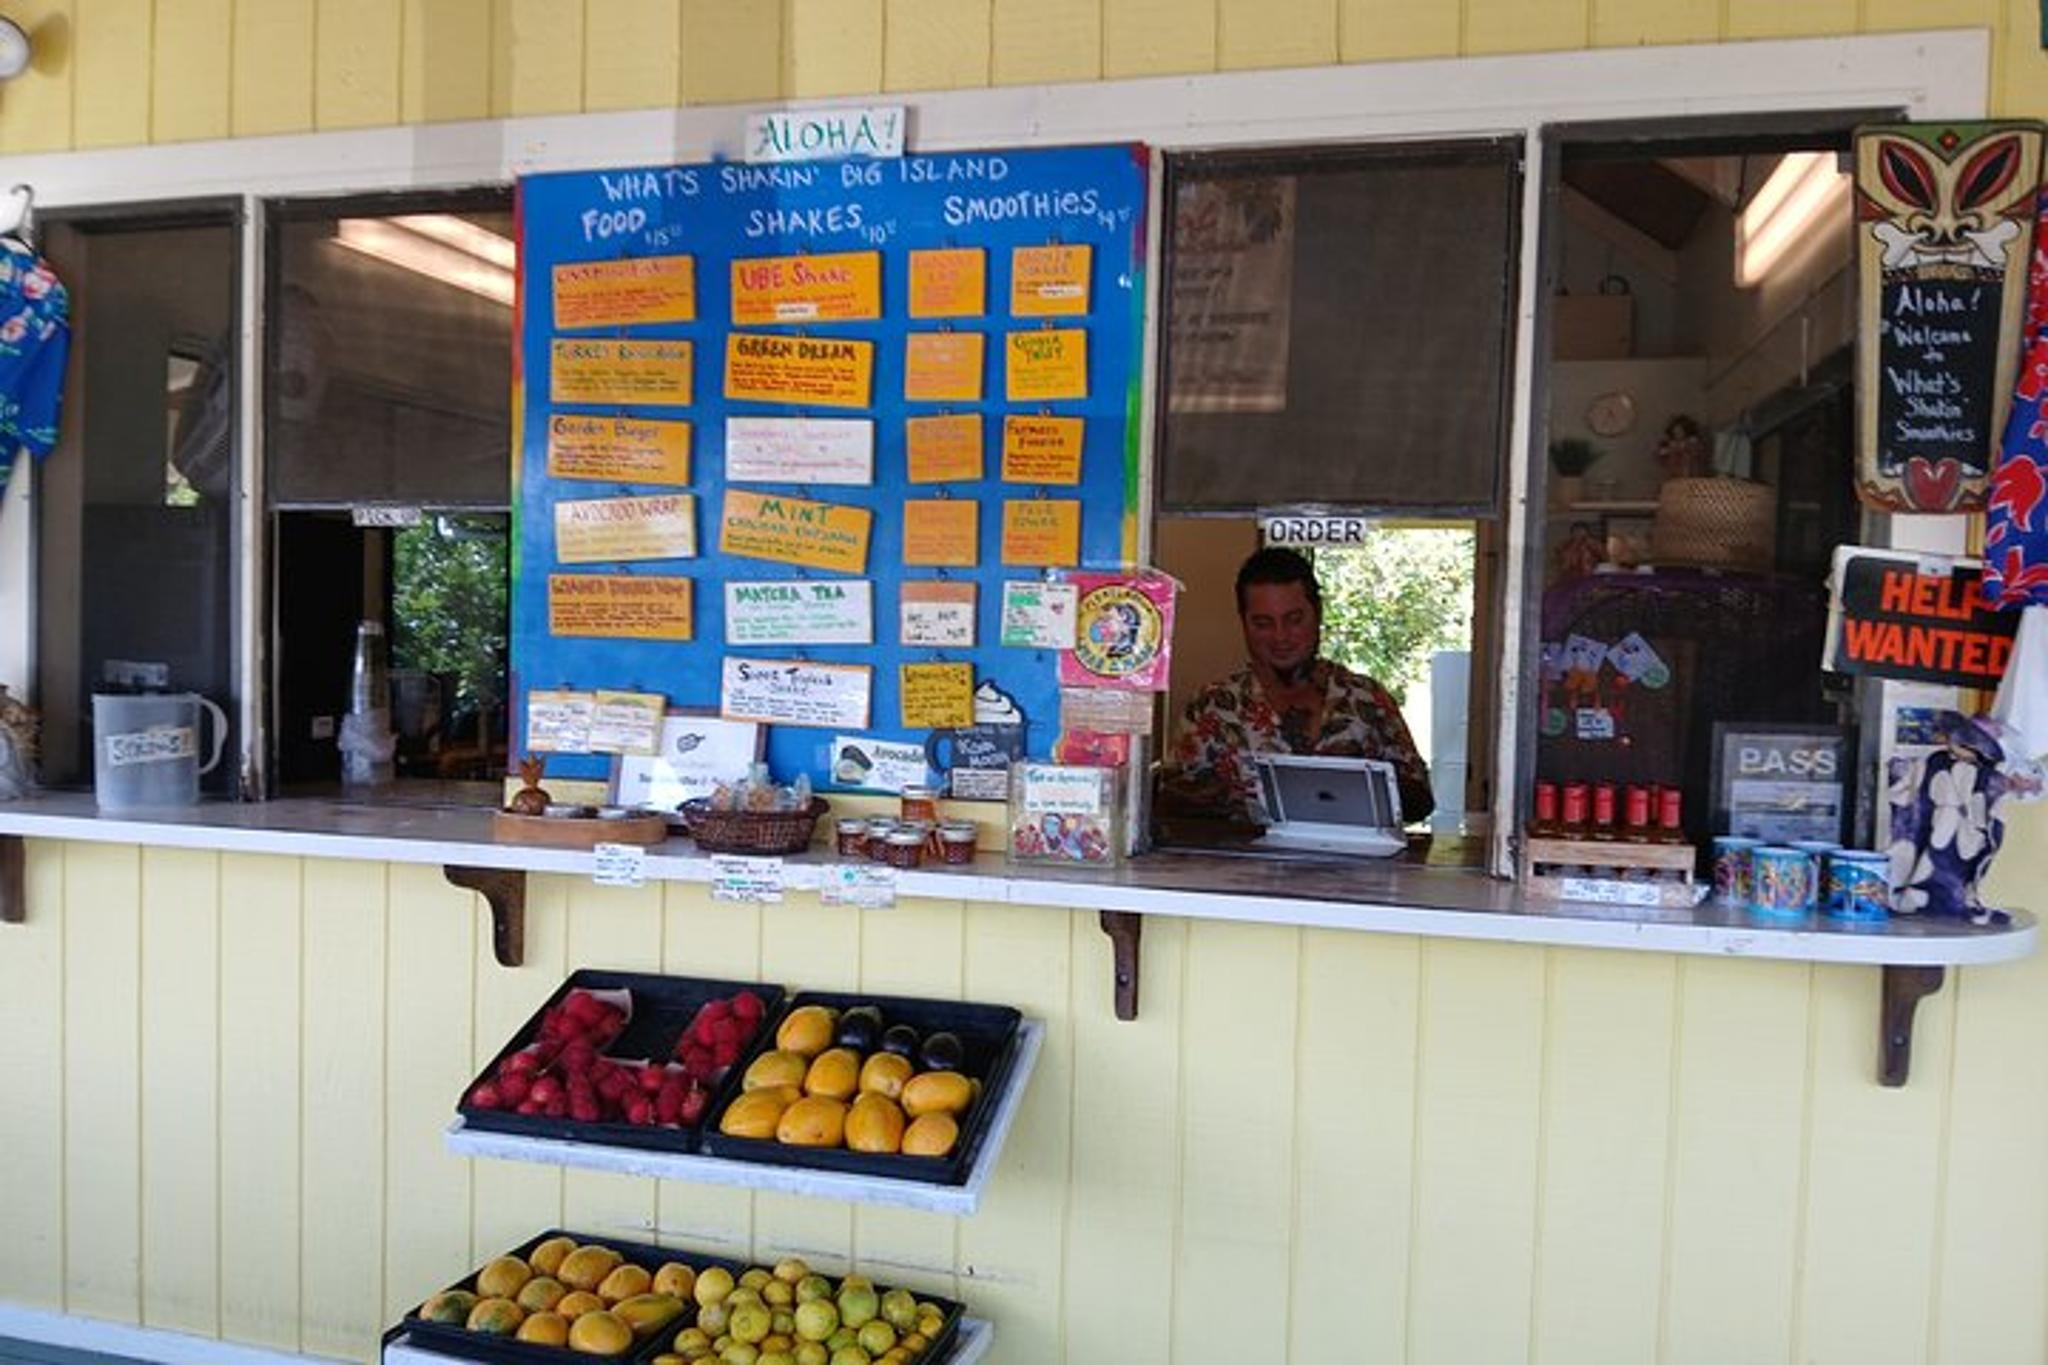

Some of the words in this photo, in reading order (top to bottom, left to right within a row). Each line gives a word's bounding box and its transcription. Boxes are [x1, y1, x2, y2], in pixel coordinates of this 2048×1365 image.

[755, 109, 898, 156] ALOHA!
[601, 172, 700, 203] WHAT'S
[720, 164, 820, 195] SHAKIN'
[840, 162, 884, 189] BIG
[899, 155, 1009, 184] ISLAND
[582, 206, 647, 243] FOOD
[745, 203, 864, 238] SHAKES
[739, 264, 783, 292] UBE
[1895, 284, 1981, 316] Aloha!
[1893, 324, 1973, 347] Welcome
[737, 338, 793, 359] GREEN
[798, 342, 857, 362] DREAM
[1887, 366, 1961, 394] What's
[759, 499, 831, 525] MINT
[1269, 520, 1361, 542] ORDER
[735, 586, 800, 604] MATCHA
[1845, 618, 2013, 676] WANTED
[1738, 748, 1837, 775] PASS
